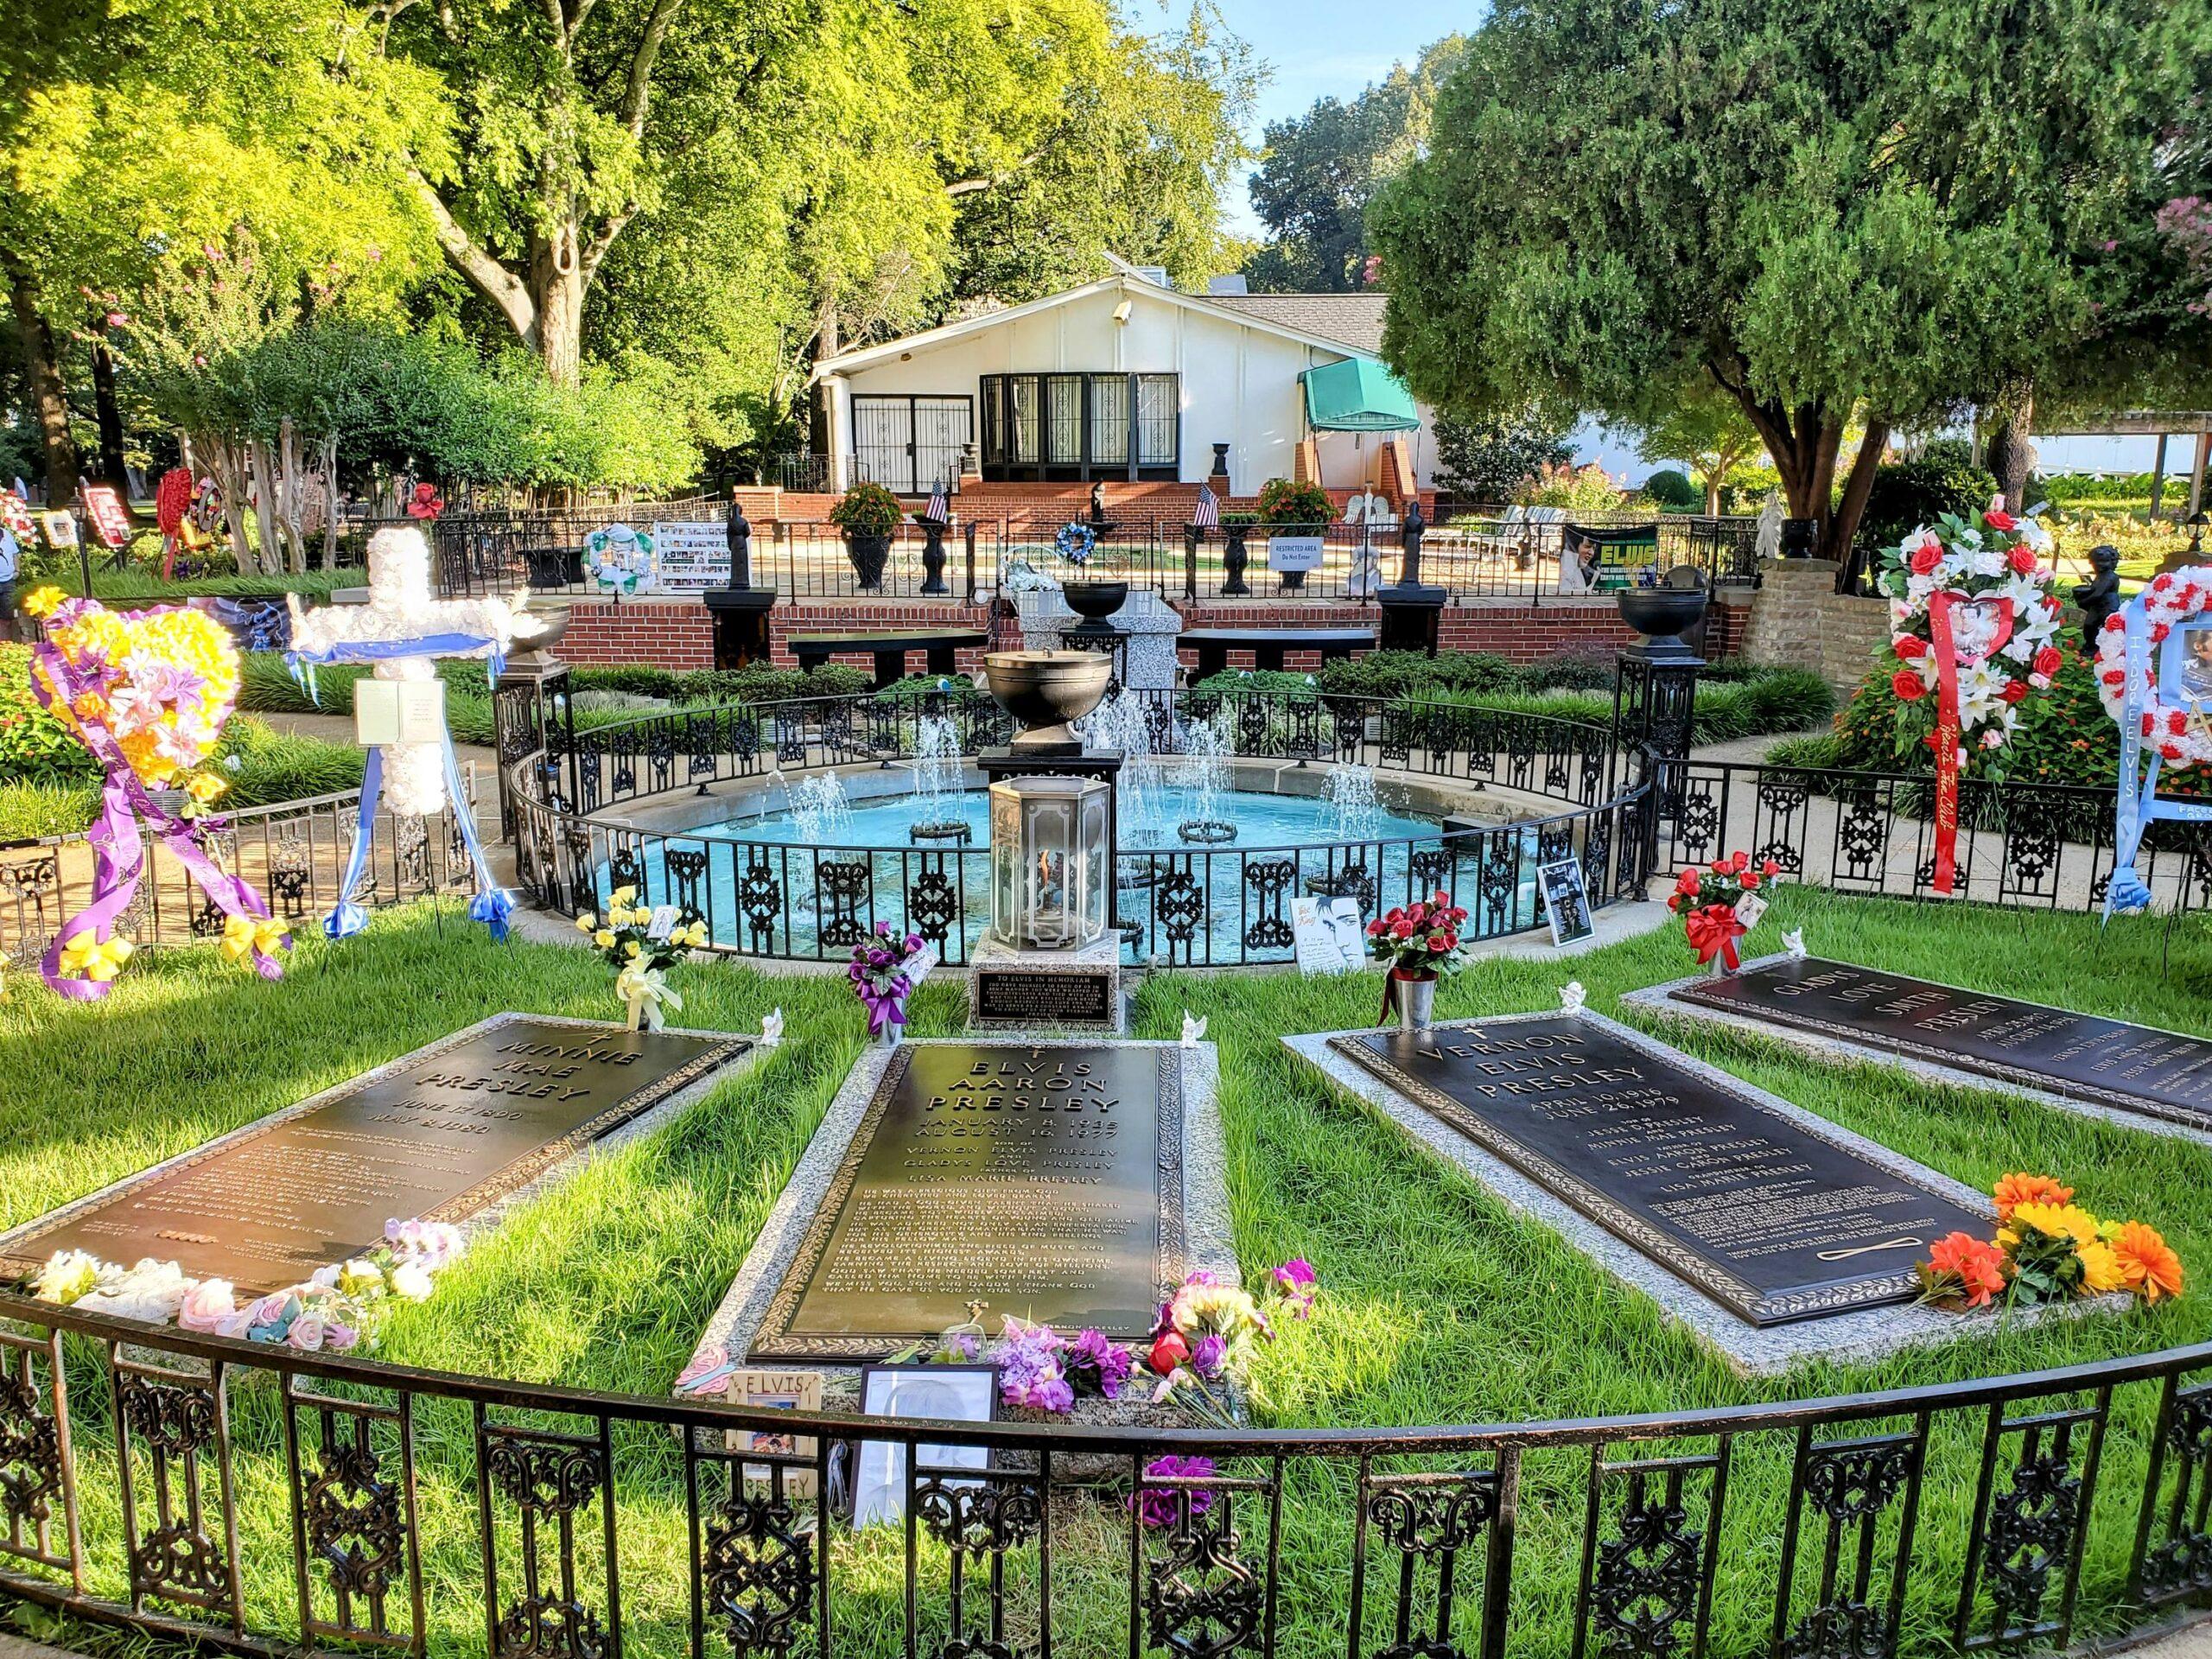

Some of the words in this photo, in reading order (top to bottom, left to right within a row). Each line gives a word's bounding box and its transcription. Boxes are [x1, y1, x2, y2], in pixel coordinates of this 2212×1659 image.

[1601, 546, 1656, 565] ELVIS
[2128, 653, 2139, 722] ADORE
[2126, 726, 2136, 798] ELVIS
[1940, 796, 1955, 830] Club
[1772, 969, 1861, 996] GLADYS
[1828, 982, 1898, 1003] LOVE
[1874, 991, 1953, 1016] SMITH
[1913, 998, 2011, 1033] PRESLEY
[496, 1042, 644, 1065] MINNIE
[1416, 1033, 1586, 1062] VERNON
[493, 1058, 582, 1078] MAE
[970, 1062, 1091, 1076] ELVIS
[1476, 1052, 1586, 1076] ELVIS
[415, 1073, 591, 1102] PRESLEY
[949, 1077, 1107, 1093] AARON
[1476, 1066, 1645, 1099] PRESLEY
[393, 1099, 448, 1113] JUNE
[925, 1096, 1120, 1113] PRESLEY
[1529, 1096, 1587, 1113] APRIL
[1544, 1106, 1598, 1122] JUNE
[1640, 1096, 1680, 1109] 1979
[367, 1112, 419, 1125] MAY
[439, 1120, 492, 1135] 1980
[914, 1128, 1017, 1137] AUGUST
[1068, 1129, 1119, 1139] 1977
[919, 1118, 1030, 1127] JANUARY
[1070, 1119, 1118, 1129] 1935
[1587, 1126, 1628, 1138] JESSE
[1646, 1116, 1706, 1129] PRESLEY
[1586, 1136, 1642, 1152] MINNIE
[1645, 1132, 1676, 1143] MAE
[1678, 1123, 1738, 1138] PRESLEY
[991, 1147, 1037, 1155] ELVIS
[1048, 1147, 1118, 1157] PRESLEY
[1607, 1154, 1650, 1167] ELVIS
[1656, 1146, 1707, 1160] AARON
[1708, 1138, 1770, 1153] PRESLEY
[1624, 1165, 1672, 1179] JESSIE
[1732, 1147, 1794, 1162] PRESLEY
[1042, 1160, 1116, 1170] PRESLEY
[908, 1174, 947, 1183] LISA
[958, 1174, 1016, 1183] MARIE
[1027, 1175, 1103, 1185] PRESLEY
[1660, 1180, 1697, 1193] LISA
[1700, 1173, 1749, 1189] MARIE
[1752, 1163, 1814, 1179] PRESLEY
[747, 1373, 804, 1394] ELVIS
